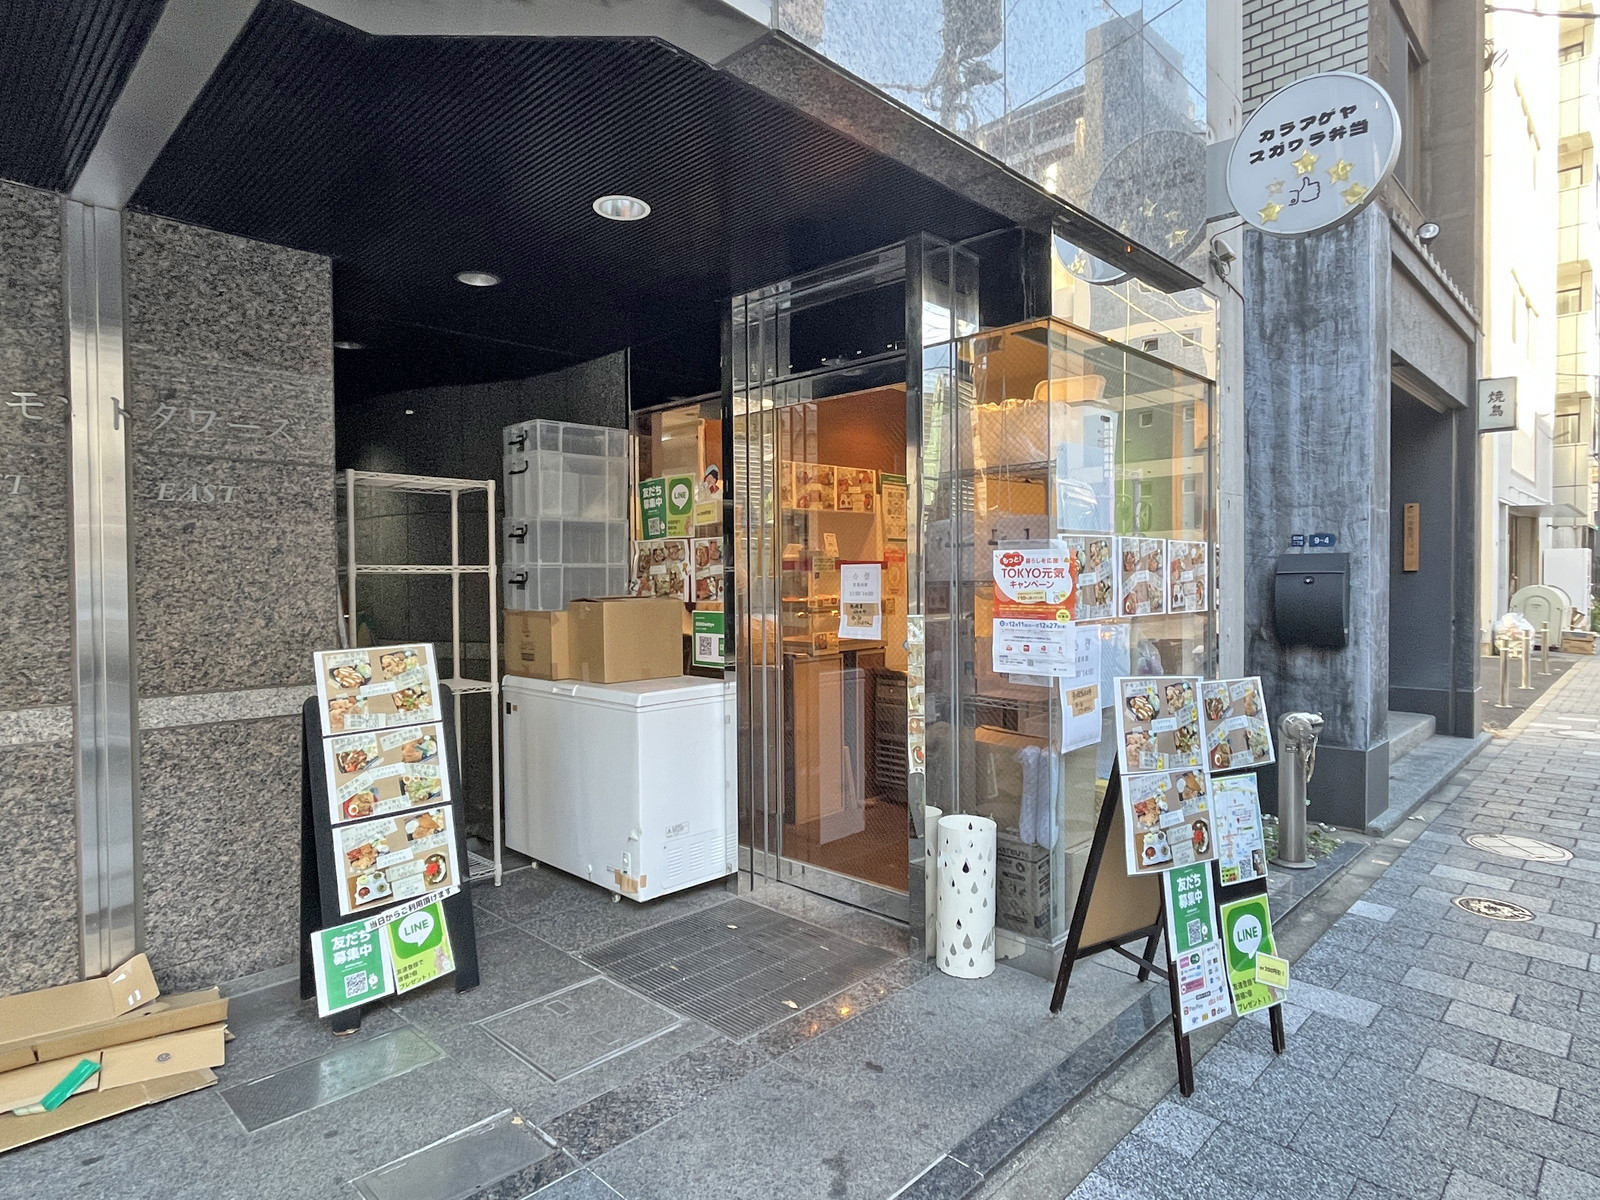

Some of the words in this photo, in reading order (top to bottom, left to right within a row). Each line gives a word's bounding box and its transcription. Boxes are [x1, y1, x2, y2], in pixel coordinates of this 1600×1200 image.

[1258, 104, 1357, 144] カラアゲヤ
[1249, 119, 1368, 165] スガワラ弁当
[1487, 390, 1506, 417] 焼鳥
[157, 483, 239, 504] EAST
[1001, 567, 1065, 579] TOKYO元気
[1009, 580, 1055, 588] キャンペーン
[1176, 873, 1202, 893] 友だち
[1178, 891, 1203, 910] 募集中
[404, 918, 429, 937] LINE
[1236, 926, 1259, 943] LINE
[331, 929, 371, 951] 友だち
[333, 945, 373, 966] 募集中
